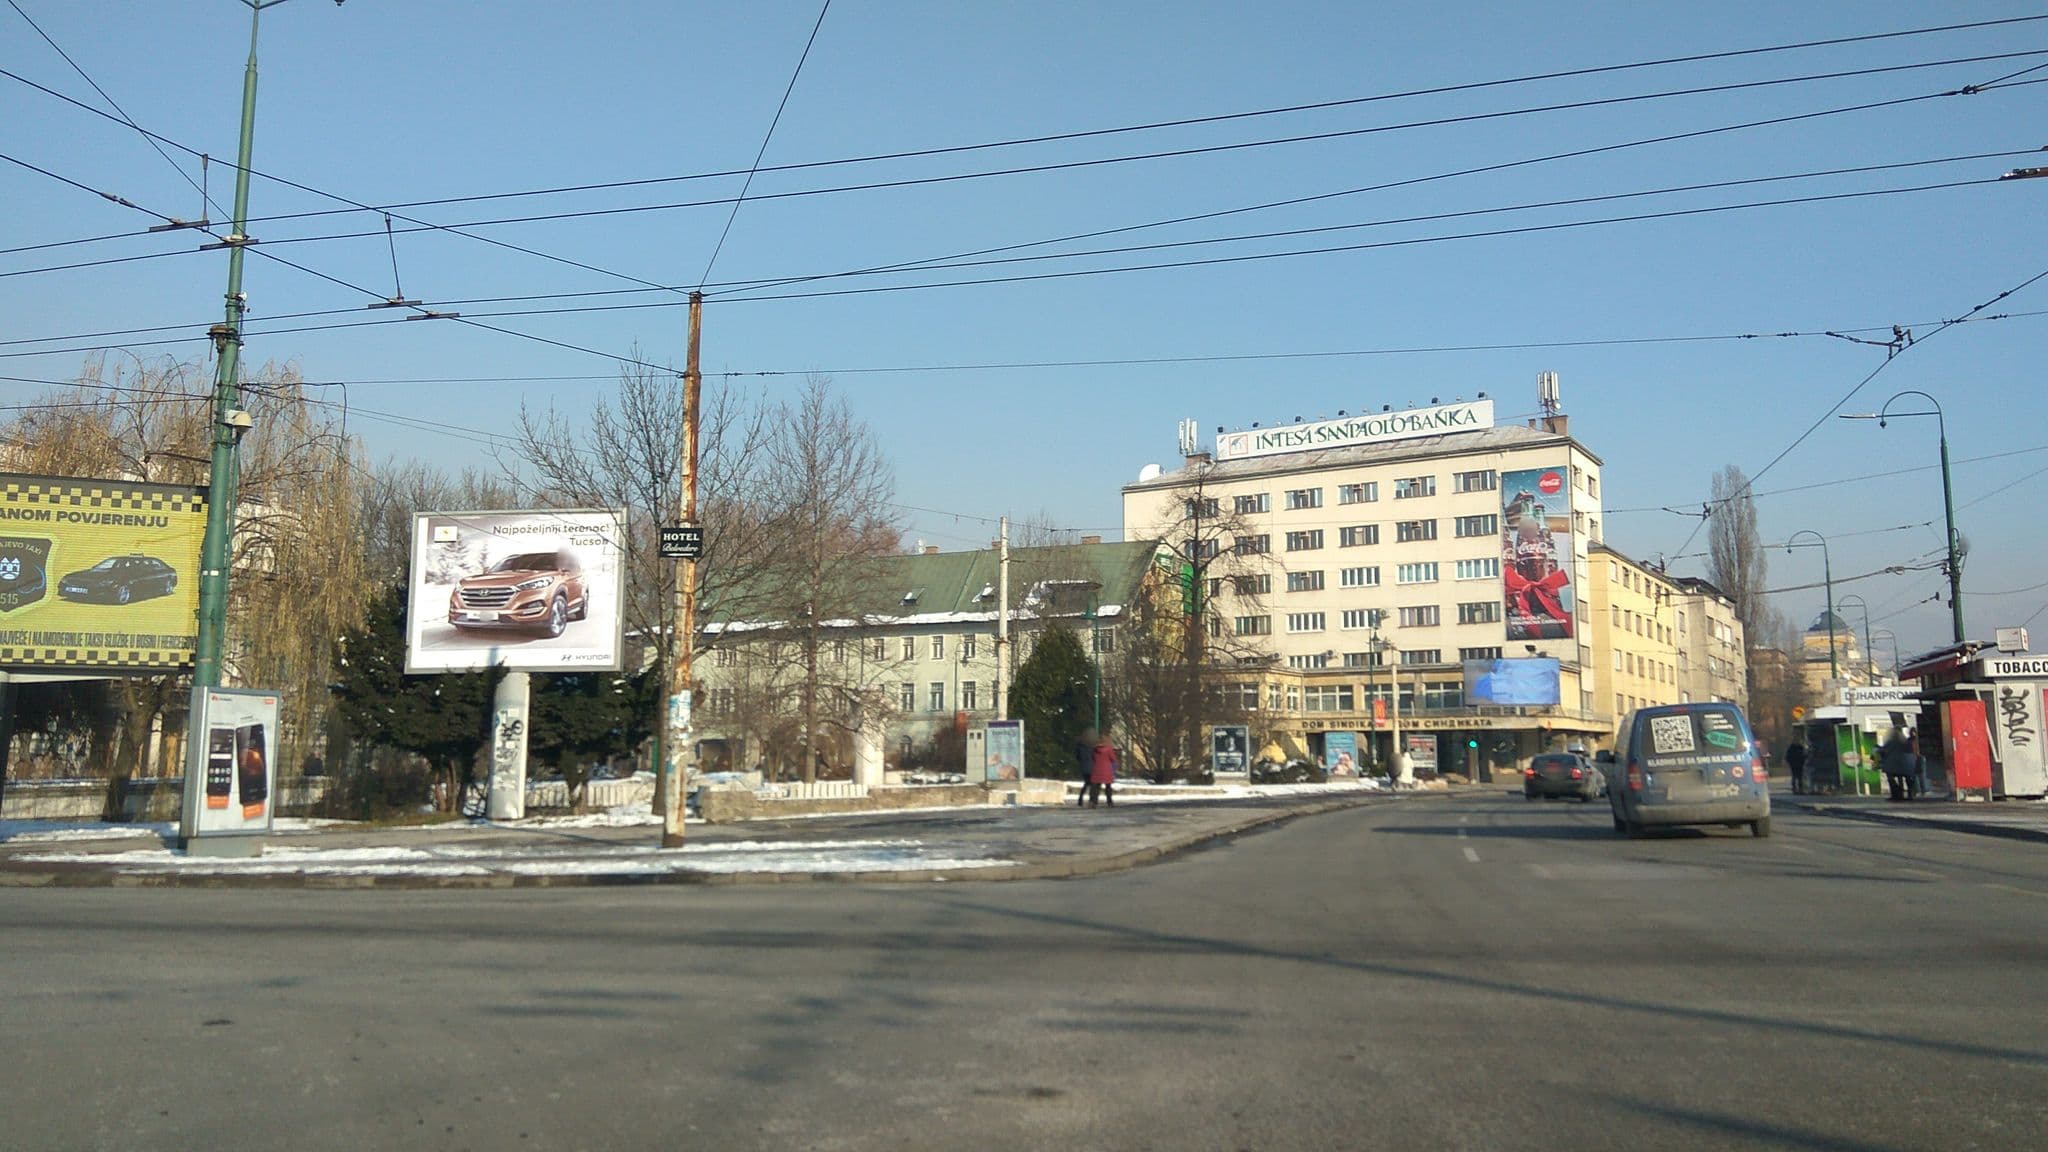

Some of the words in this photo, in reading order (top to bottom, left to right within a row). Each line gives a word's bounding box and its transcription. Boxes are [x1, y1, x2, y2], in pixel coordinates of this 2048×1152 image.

[1256, 429, 1312, 450] INTESA
[1317, 417, 1406, 442] SANPAOLO
[1411, 409, 1478, 429] BANKA
[56, 511, 169, 528] POVJERENJU
[663, 532, 700, 541] HOTEL
[569, 537, 609, 546] Tucson
[1302, 720, 1324, 729] DOM
